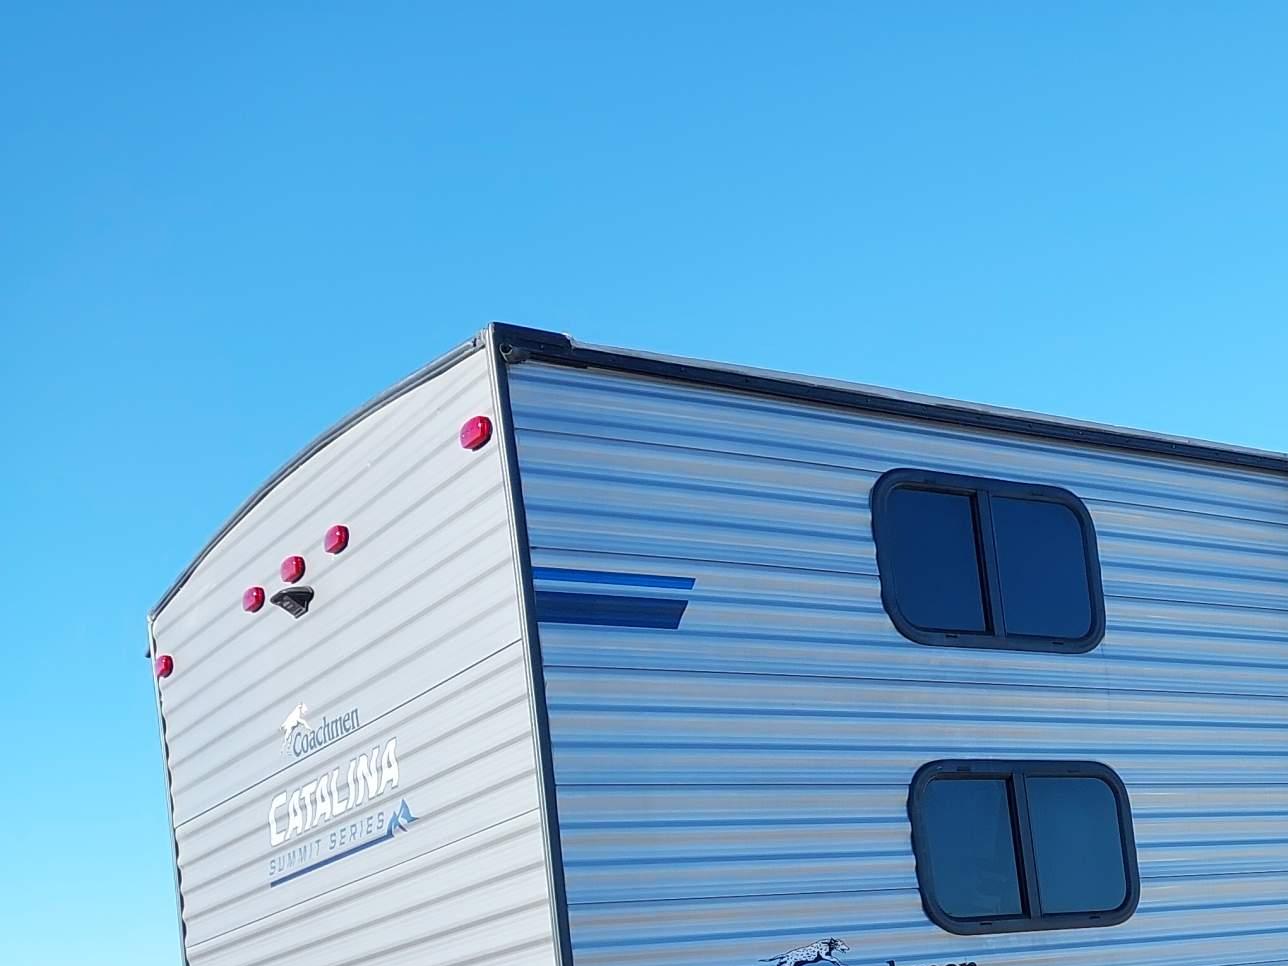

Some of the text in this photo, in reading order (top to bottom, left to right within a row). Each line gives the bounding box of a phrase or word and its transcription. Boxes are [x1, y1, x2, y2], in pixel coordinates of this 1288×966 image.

[292, 708, 360, 758] Coachmen
[268, 736, 400, 848] CATALINA
[268, 811, 386, 876] SUMMIT SERIES
